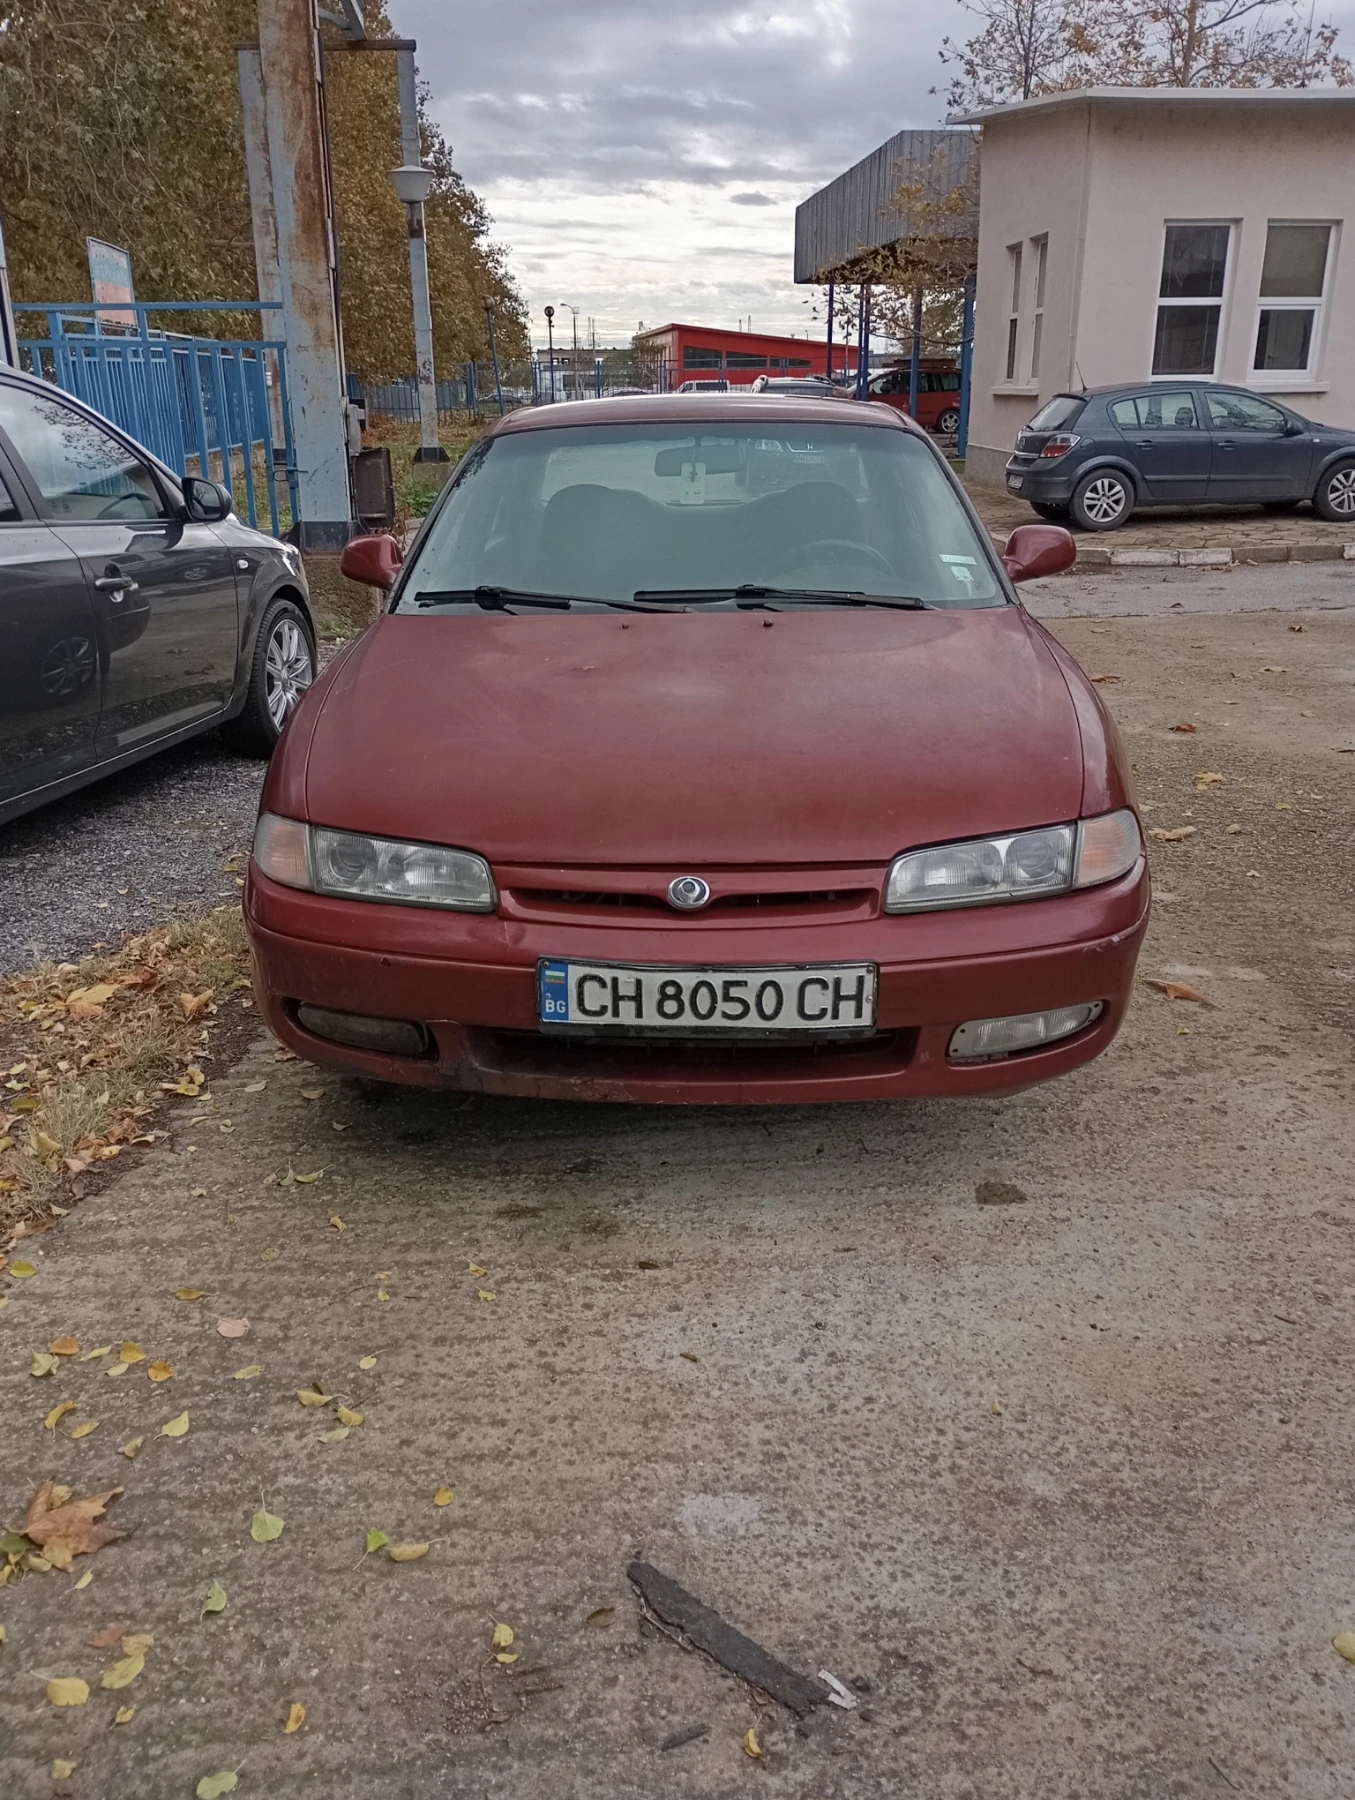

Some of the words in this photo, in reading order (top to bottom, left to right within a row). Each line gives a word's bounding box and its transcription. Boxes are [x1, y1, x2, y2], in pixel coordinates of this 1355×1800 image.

[545, 999, 566, 1014] BG
[576, 973, 643, 1019] CH
[656, 979, 784, 1021] 8050
[797, 975, 865, 1021] CH
